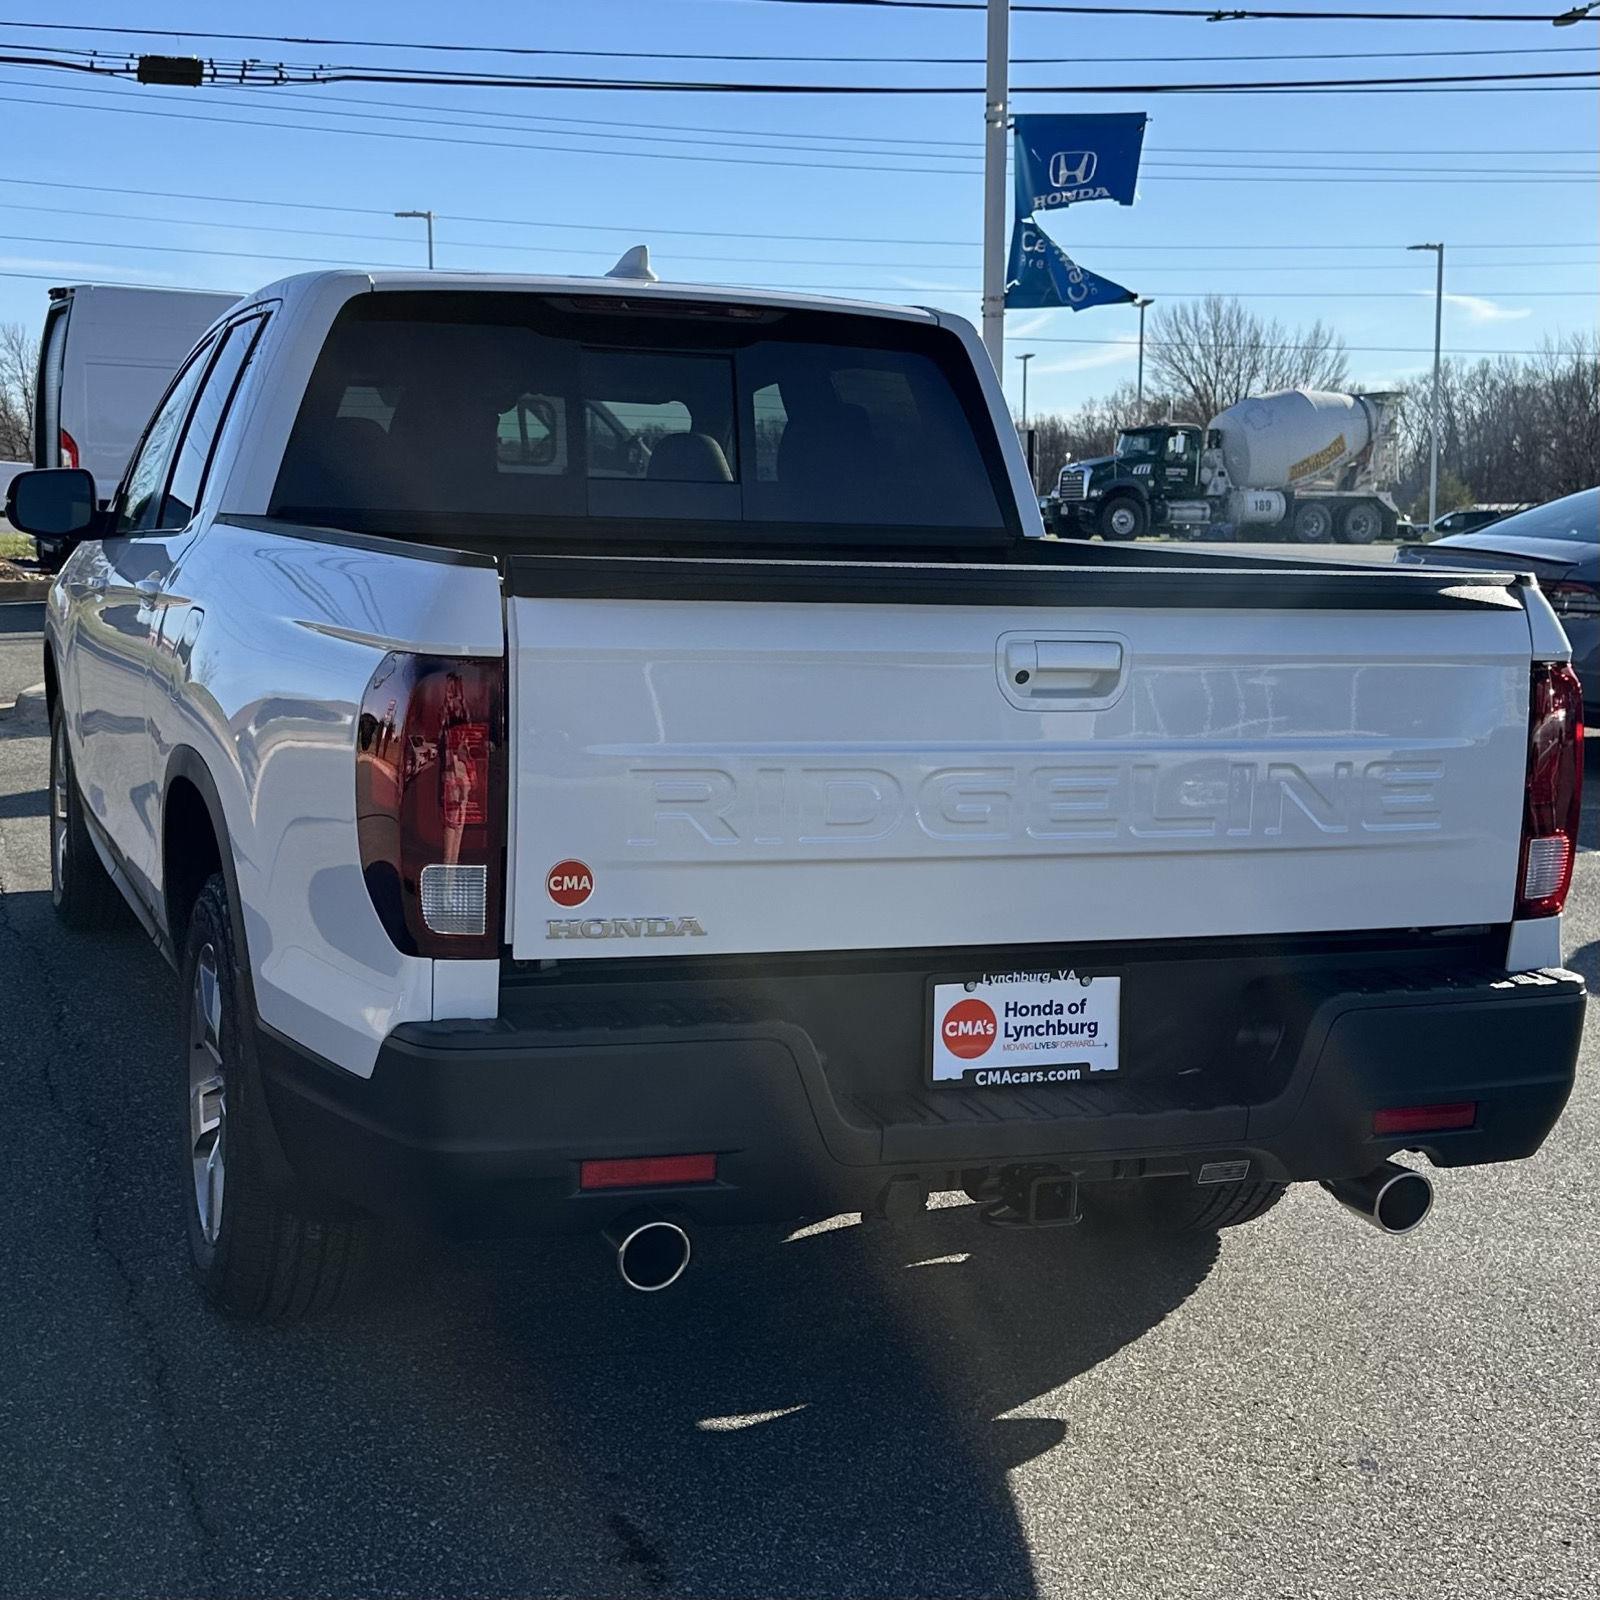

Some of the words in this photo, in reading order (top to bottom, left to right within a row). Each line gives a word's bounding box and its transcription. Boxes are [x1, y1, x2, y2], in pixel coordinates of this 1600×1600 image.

[1032, 187, 1111, 209] HONDA
[1254, 499, 1272, 512] 189
[627, 760, 1446, 847] RIDGELINE
[549, 875, 592, 892] CMA
[545, 916, 708, 940] HONDA
[1058, 969, 1077, 981] VA
[1004, 1000, 1064, 1018] Honda
[1067, 998, 1088, 1015] of
[944, 1019, 995, 1037] CMA's
[1004, 1019, 1099, 1042] Lynchburg
[975, 1068, 1081, 1086] CMAcars.com
